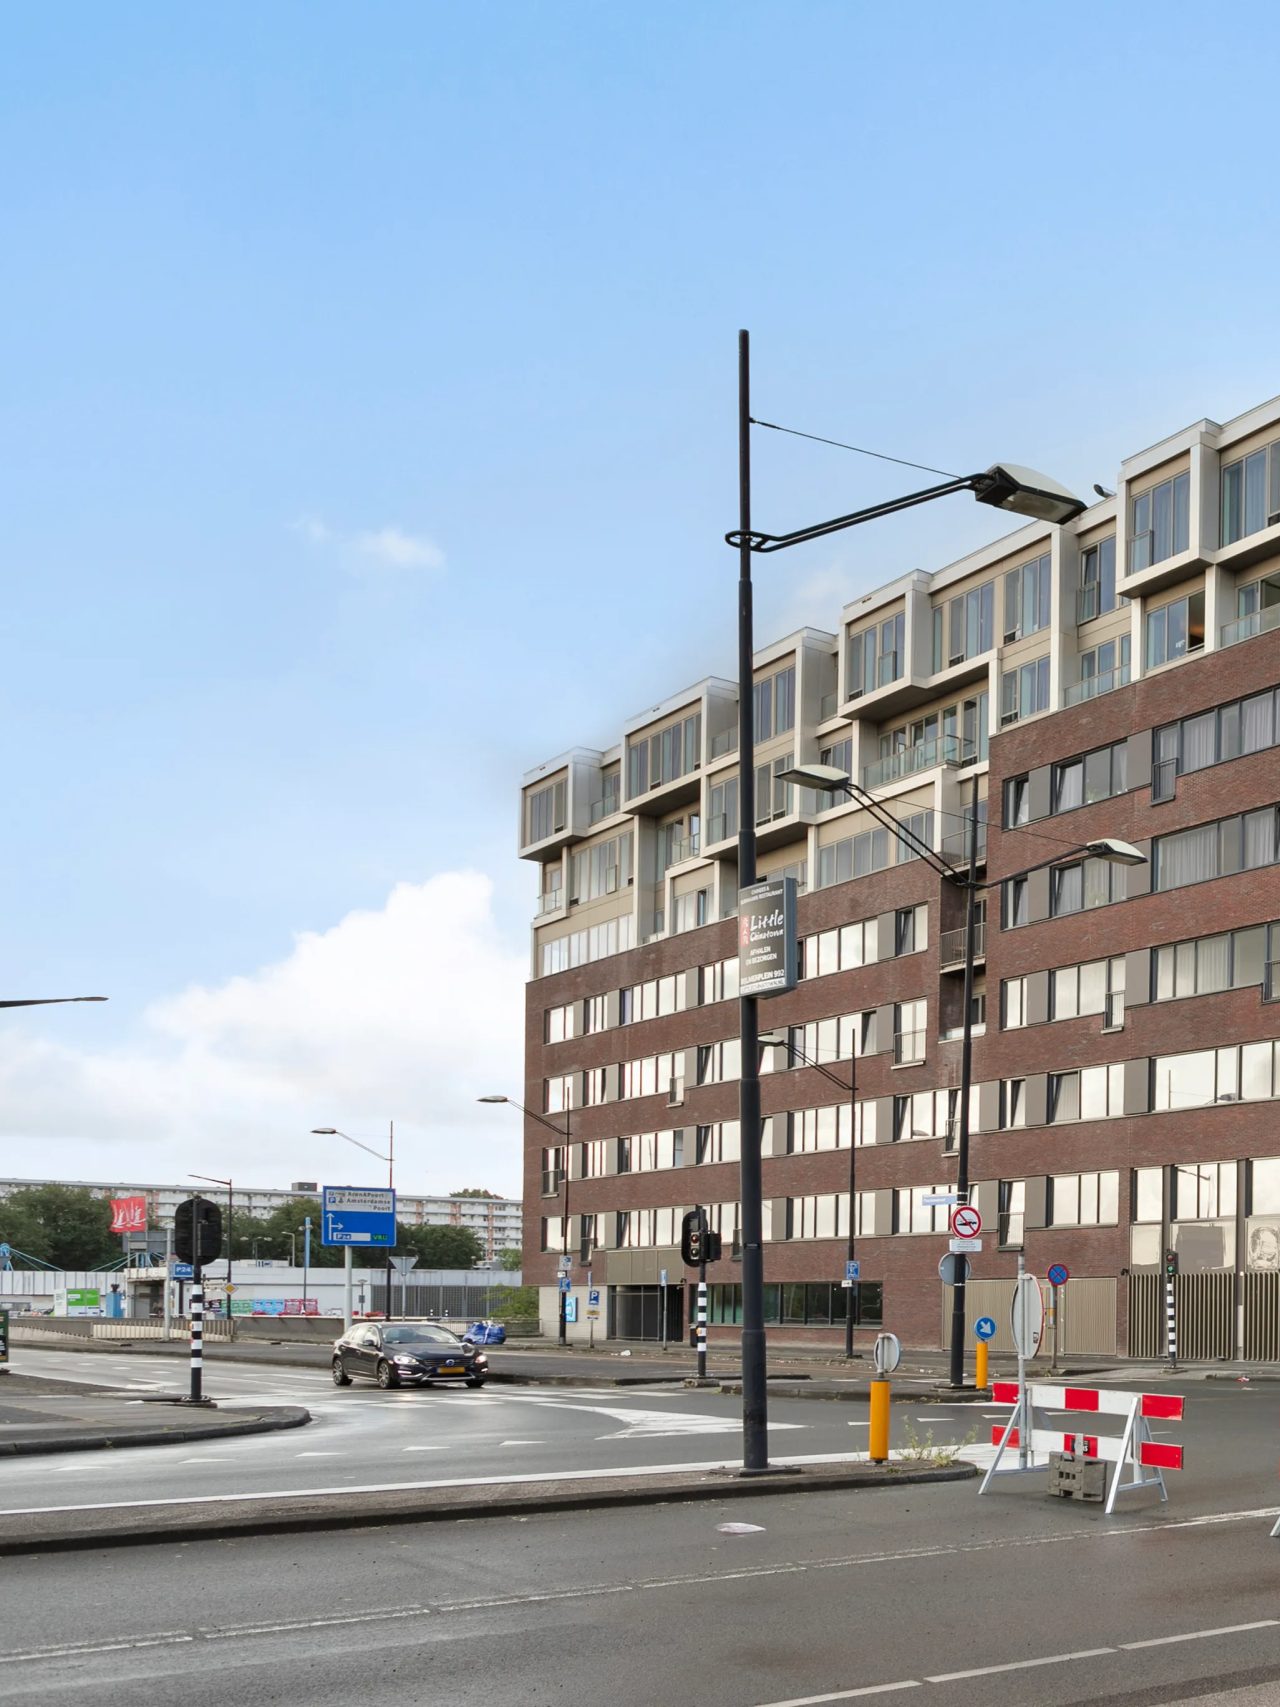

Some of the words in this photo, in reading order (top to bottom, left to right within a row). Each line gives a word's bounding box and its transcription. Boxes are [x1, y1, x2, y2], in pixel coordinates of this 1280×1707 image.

[750, 909, 784, 931] Little
[750, 929, 784, 941] Chinatown
[750, 946, 771, 956] AFHALEN
[751, 953, 777, 964] BEZORGEN
[773, 968, 785, 977] 992
[591, 1291, 598, 1300] P
